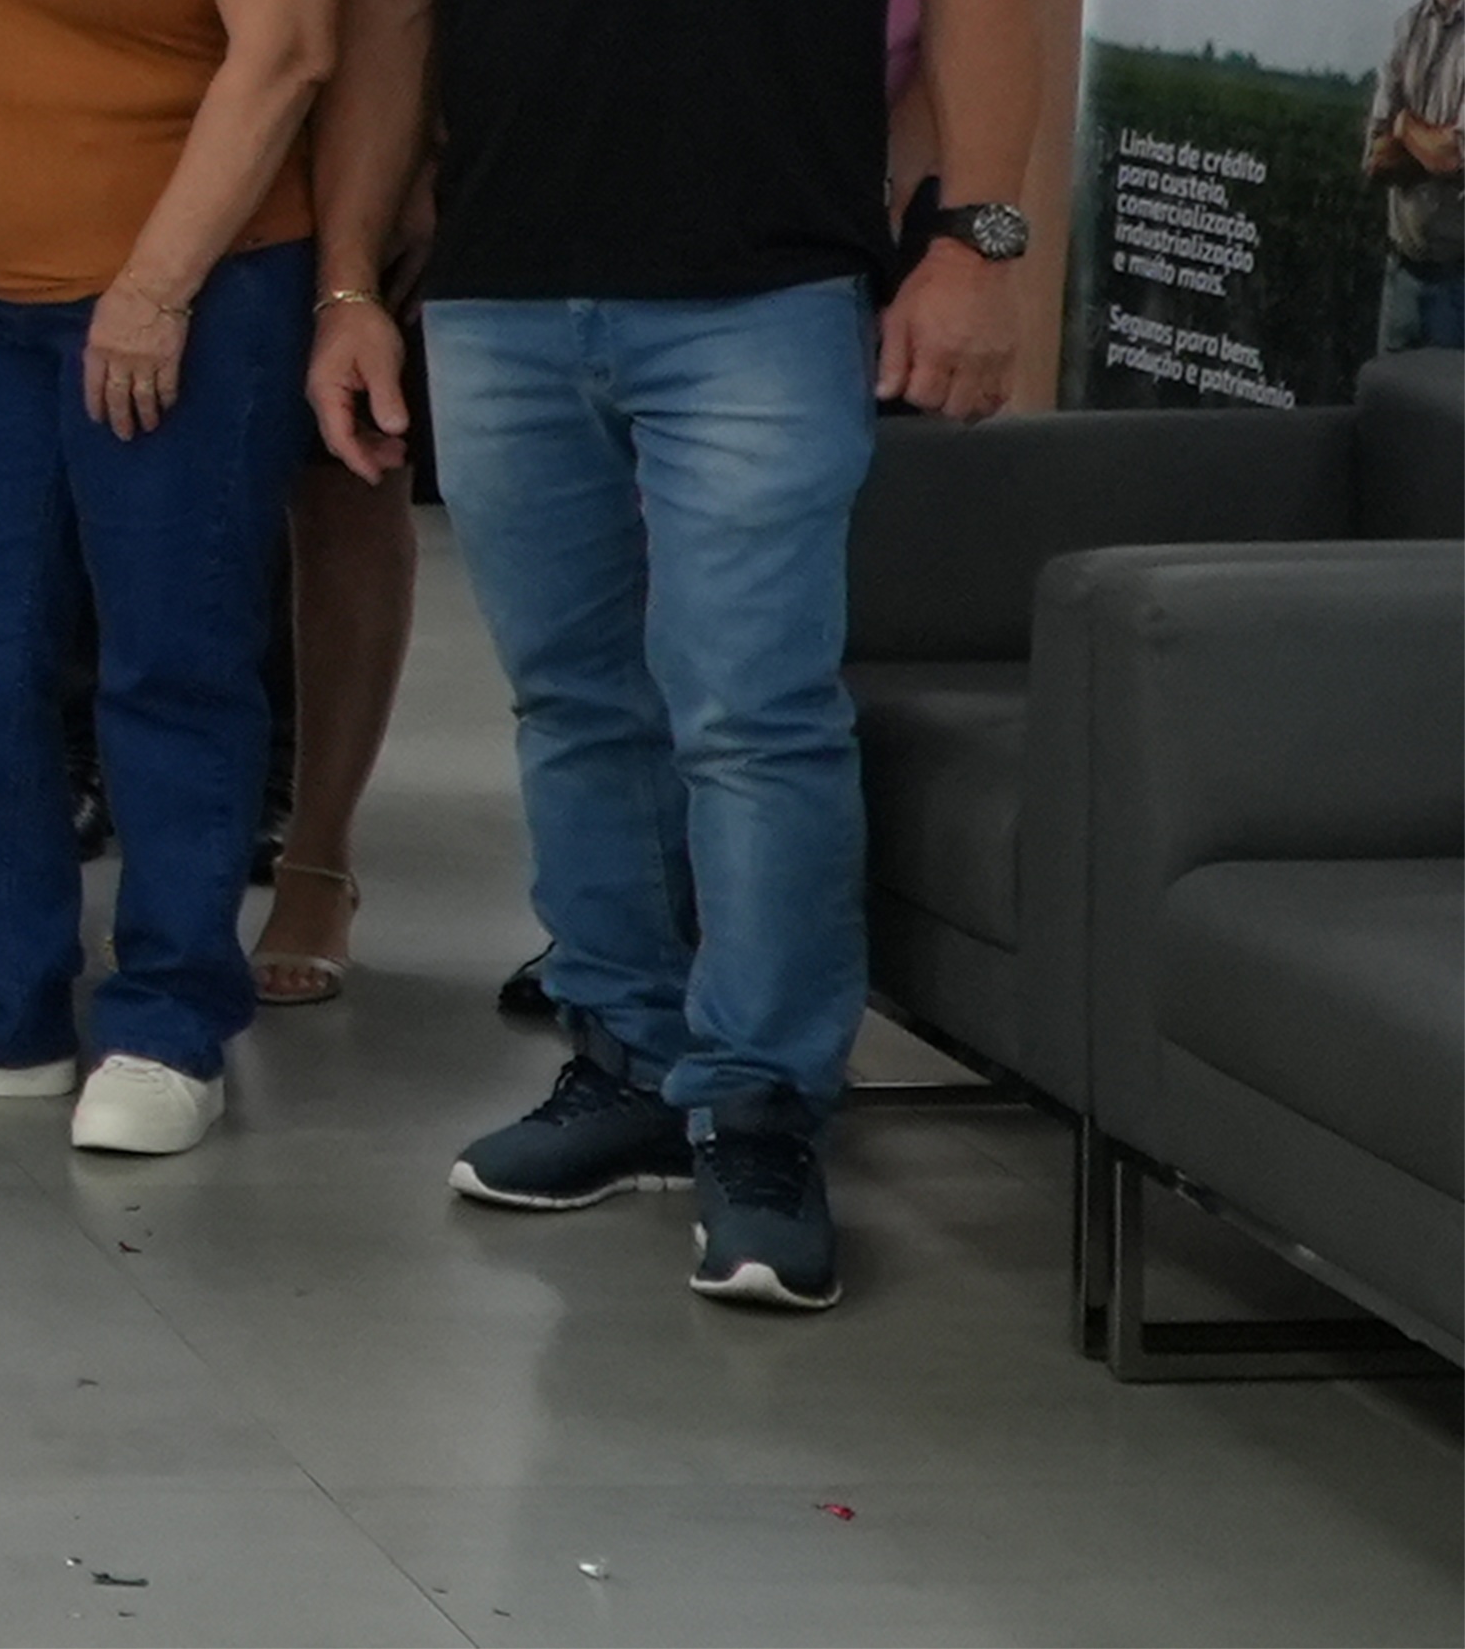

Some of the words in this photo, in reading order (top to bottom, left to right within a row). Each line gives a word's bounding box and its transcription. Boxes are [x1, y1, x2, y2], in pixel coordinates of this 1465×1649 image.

[1120, 127, 1176, 165] Linhas
[1176, 140, 1201, 171] de
[1201, 149, 1267, 185] crédito
[1116, 163, 1159, 190] para
[1160, 174, 1230, 211] custeio,
[1113, 214, 1255, 277] industrialização
[1116, 192, 1261, 249] comercialização,
[1112, 250, 1127, 273] e
[1127, 252, 1176, 286] muito
[1176, 266, 1228, 298] mais.
[1108, 303, 1175, 344] Seguros
[1174, 328, 1219, 357] para
[1107, 341, 1183, 385] produção
[1184, 361, 1199, 386] e
